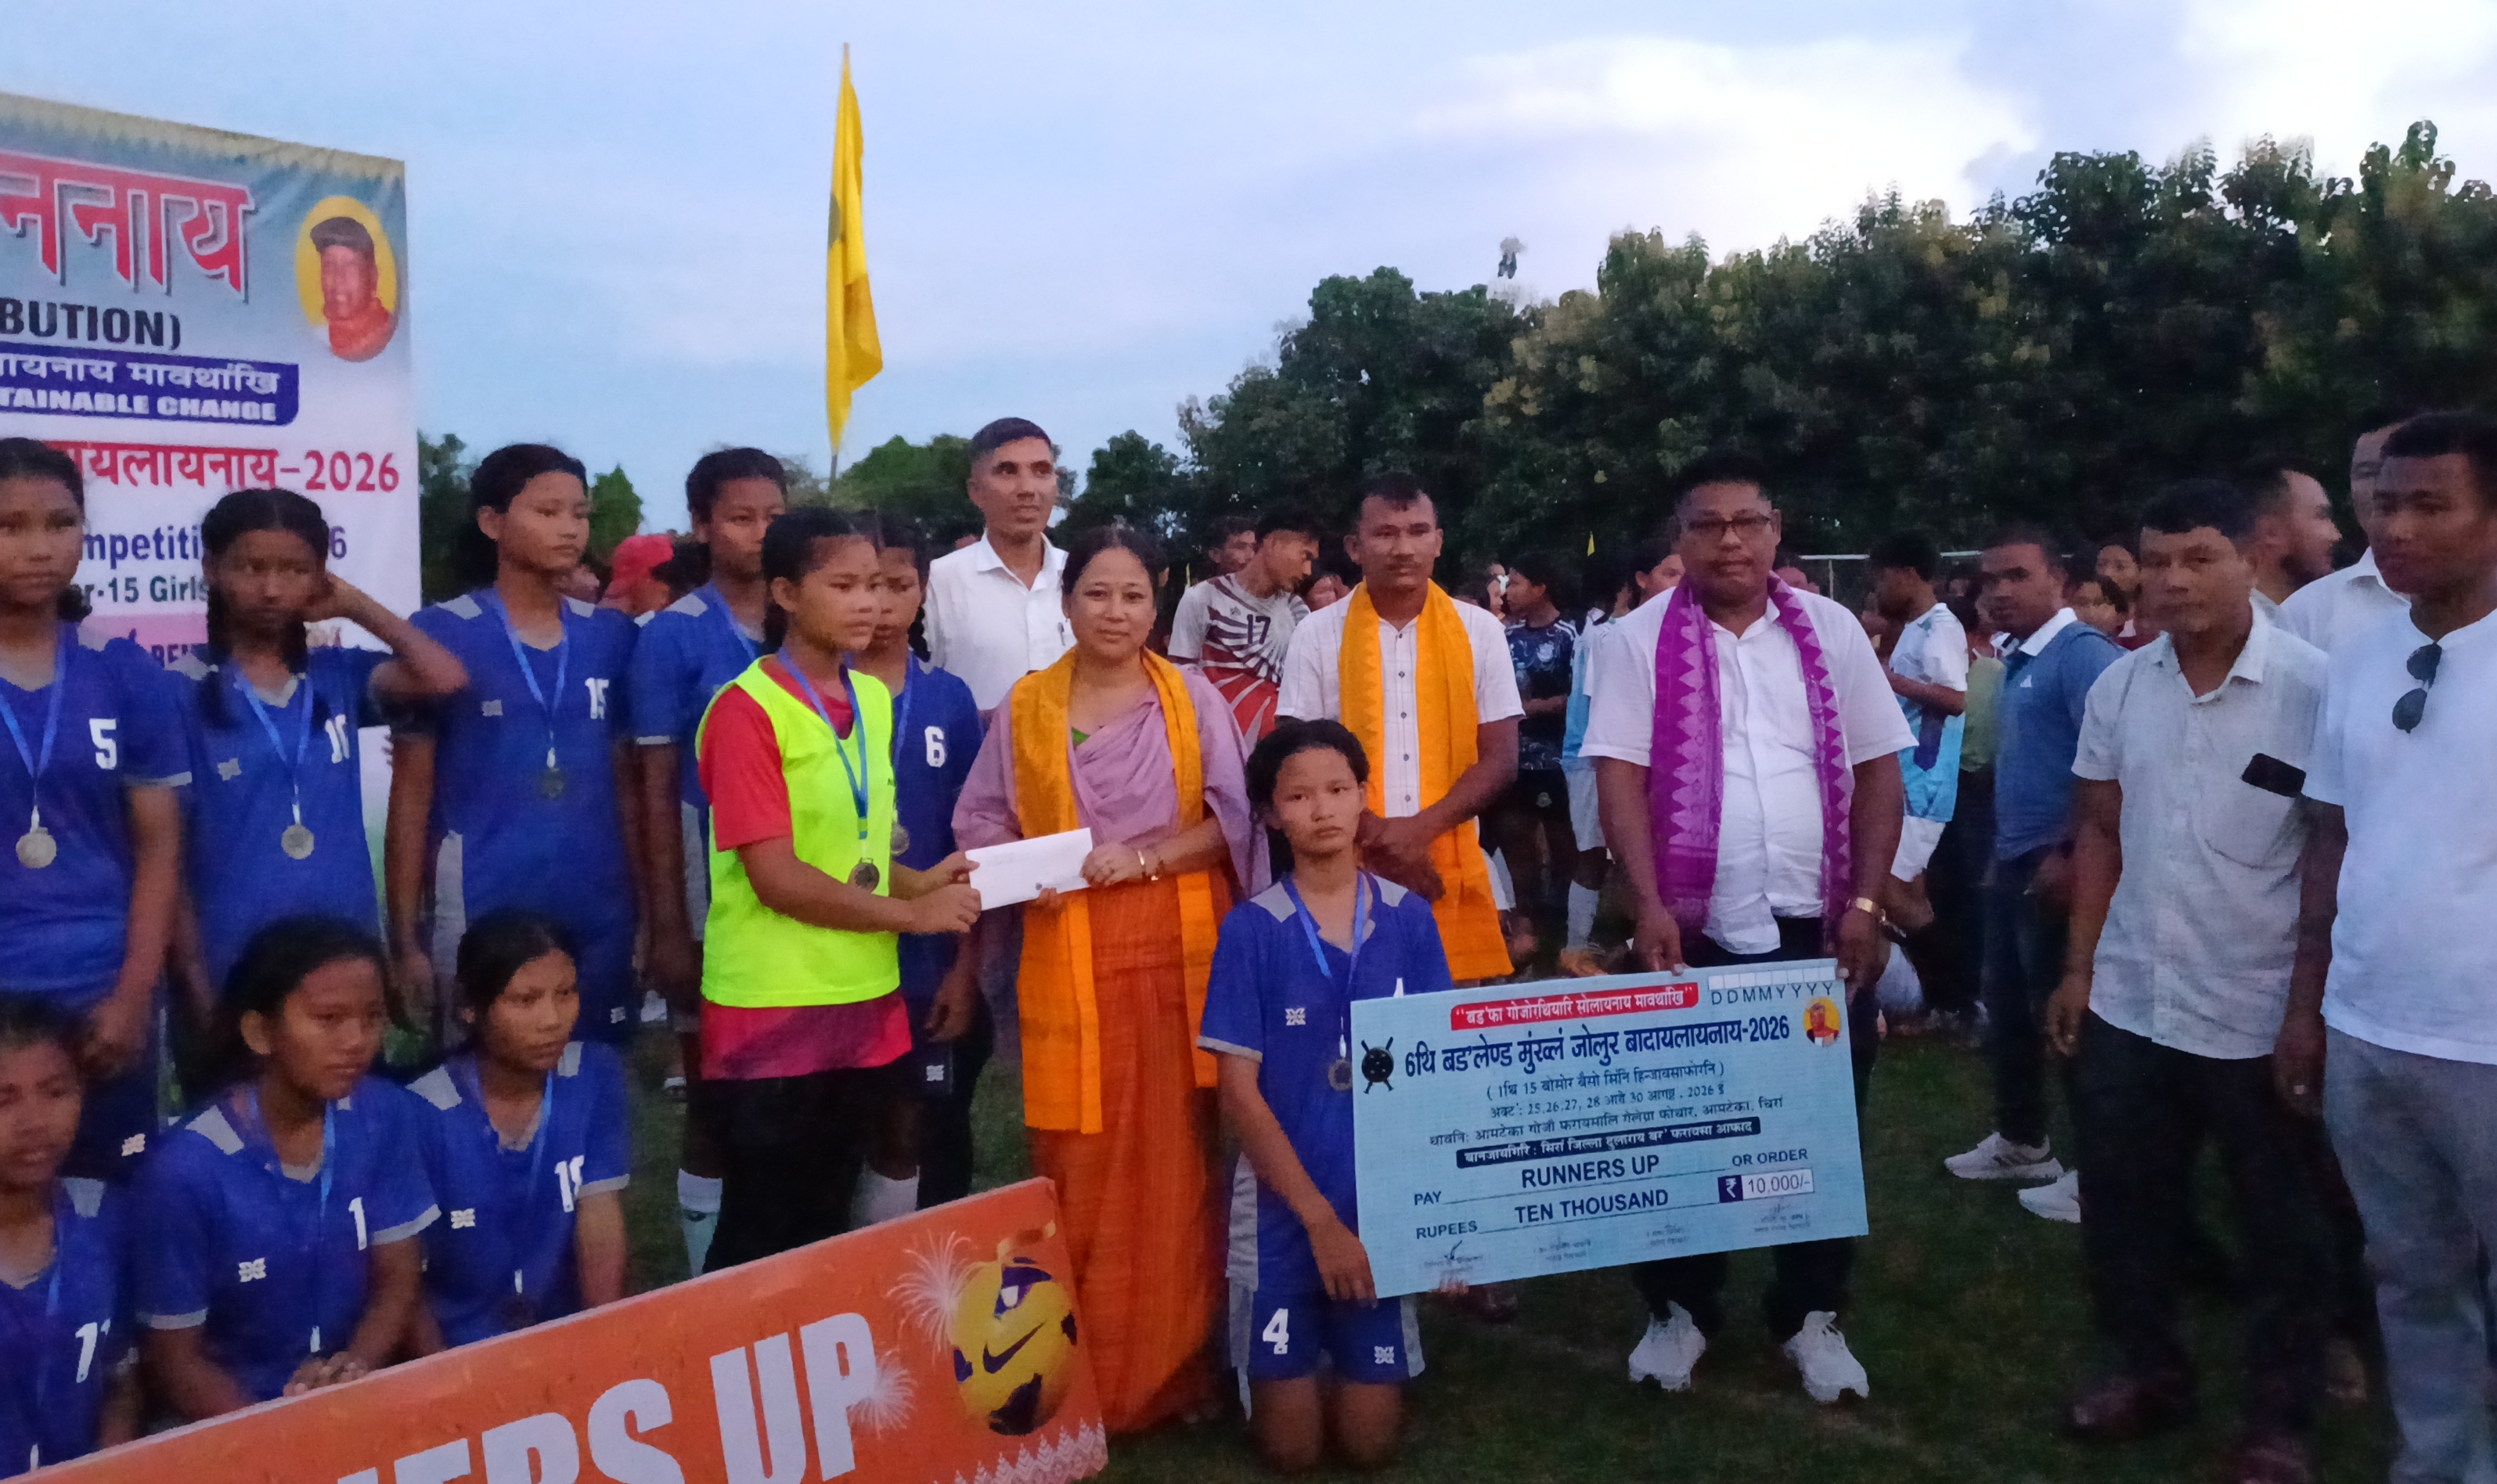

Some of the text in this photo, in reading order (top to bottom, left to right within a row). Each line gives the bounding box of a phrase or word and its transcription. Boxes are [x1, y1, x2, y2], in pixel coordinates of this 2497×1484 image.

[0, 353, 117, 384] ायनाय
[43, 441, 400, 492] ायलायनाय-2026
[83, 524, 203, 569] mpetiti
[1247, 614, 1271, 645] 17
[89, 718, 117, 770] 5
[924, 726, 946, 768] 6
[1405, 1040, 1436, 1077] 6थि
[1569, 1023, 1620, 1066] जोलुर
[1623, 1015, 1790, 1053] बादायलायनाय-2026
[1523, 1082, 1537, 1095] 15
[1587, 1095, 1601, 1109] 28
[1688, 1084, 1714, 1098] 2026
[1414, 1148, 1808, 1206] PAY RUNNERS UP OR ORDER
[1415, 1219, 1478, 1240] RUPEES
[1514, 1202, 1553, 1223] TEN
[1559, 1189, 1669, 1218] THOUSAND
[1748, 1173, 1811, 1194] 10,000/-
[1262, 1308, 1289, 1355] 4
[709, 1311, 877, 1484] UP
